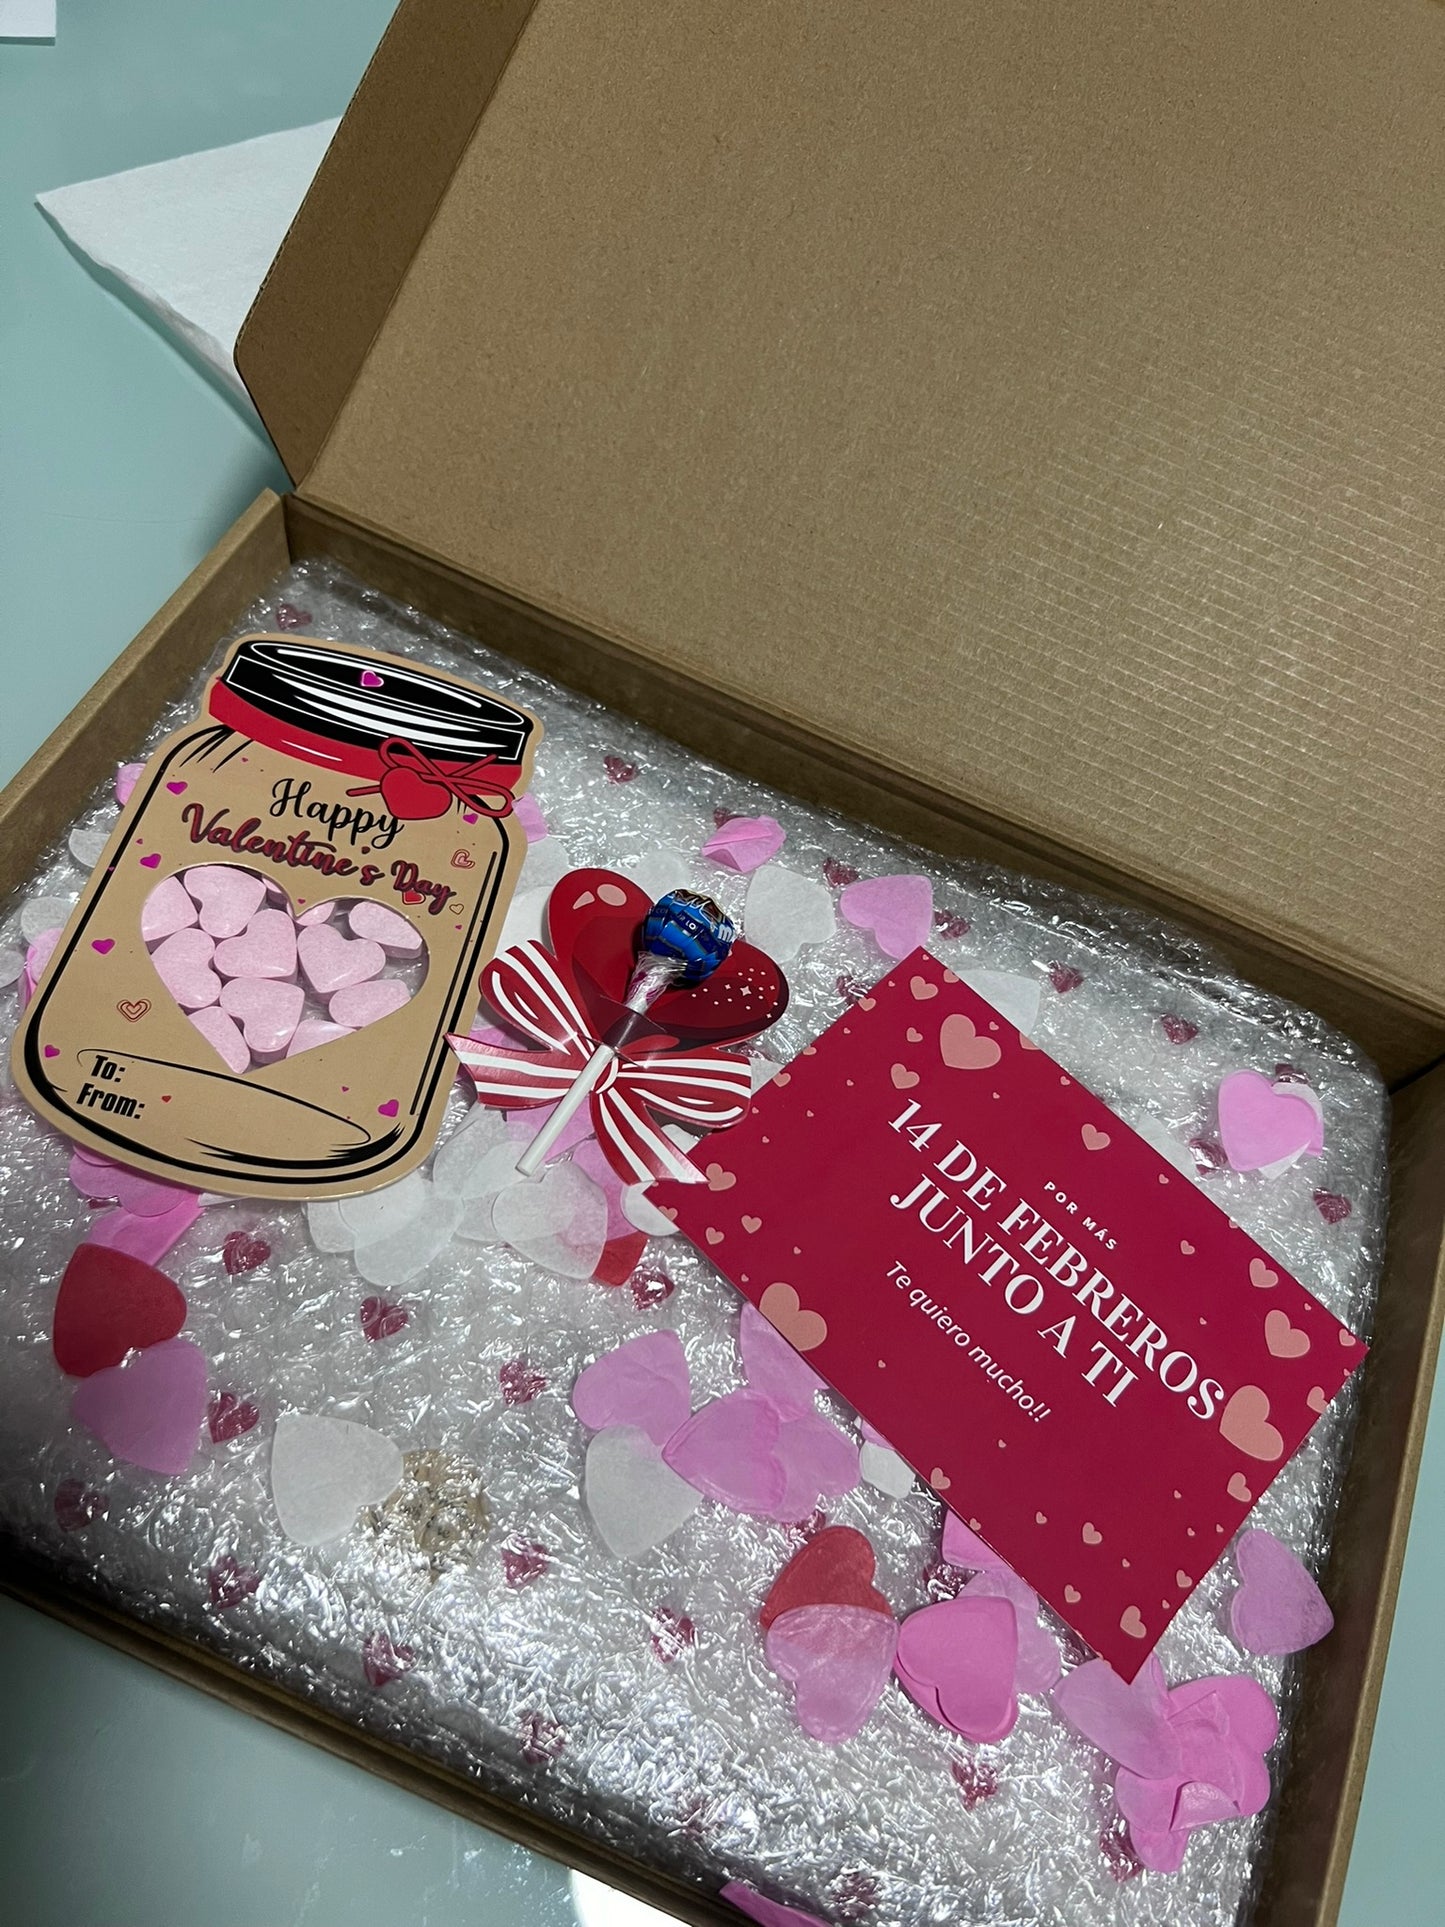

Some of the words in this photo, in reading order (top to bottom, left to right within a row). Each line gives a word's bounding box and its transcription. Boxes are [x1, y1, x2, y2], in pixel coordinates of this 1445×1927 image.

[181, 803, 385, 886] Valentine's
[390, 860, 457, 915] Day
[269, 777, 404, 849] Happy
[76, 1082, 145, 1119] From:
[91, 1054, 125, 1082] To:
[887, 1098, 943, 1152] 14
[933, 1140, 1007, 1211] DE
[997, 1198, 1225, 1420] FEBREROS
[1043, 1181, 1079, 1215] POR
[1082, 1216, 1117, 1250] MÁS
[890, 1173, 1044, 1315] JUNTO
[1037, 1315, 1078, 1358] A
[1081, 1341, 1139, 1407] TI
[886, 1260, 911, 1290] Te
[909, 1286, 971, 1347] quiero
[968, 1344, 1051, 1422] mucho!!
